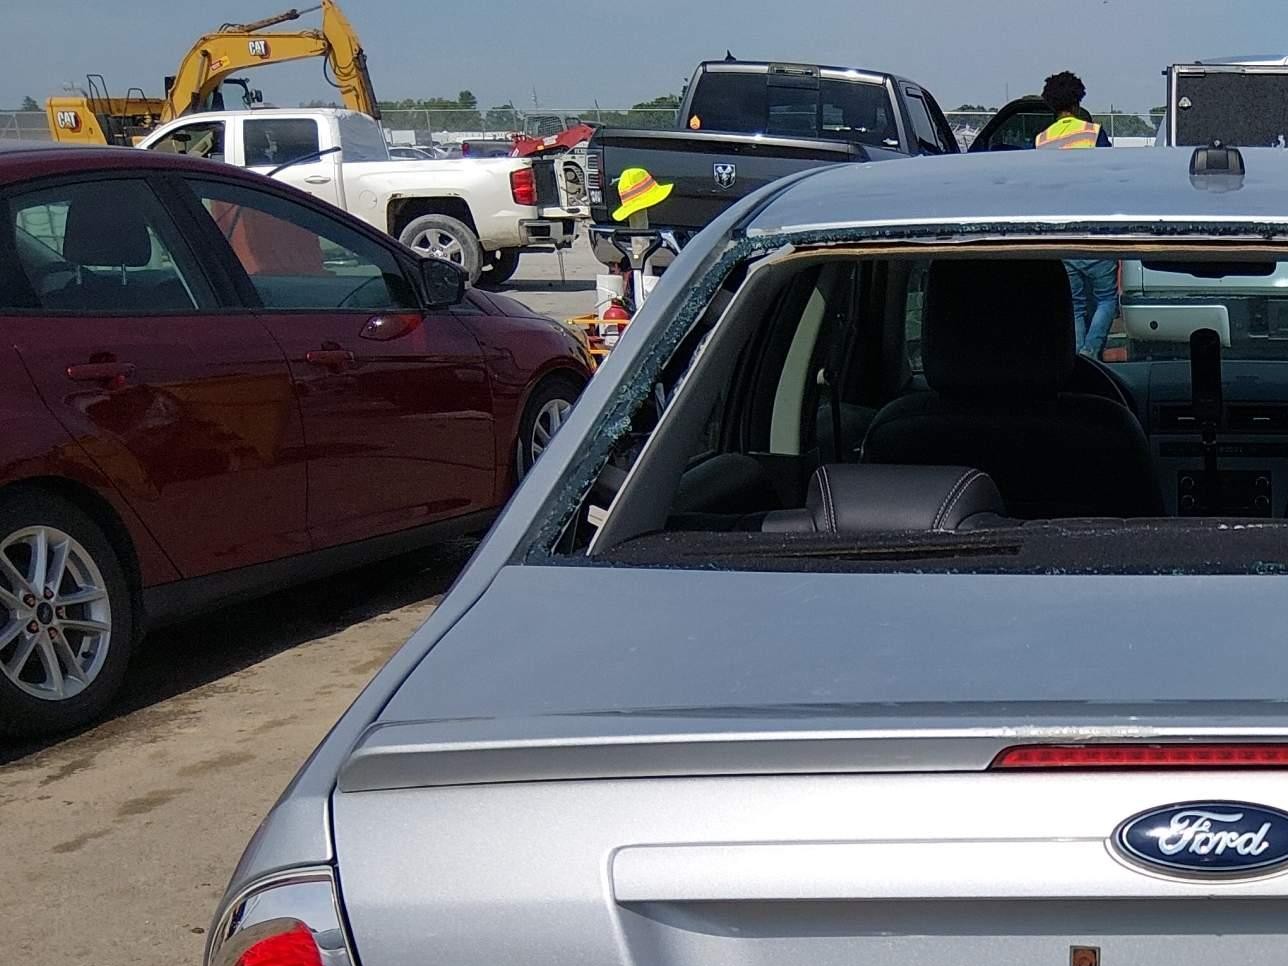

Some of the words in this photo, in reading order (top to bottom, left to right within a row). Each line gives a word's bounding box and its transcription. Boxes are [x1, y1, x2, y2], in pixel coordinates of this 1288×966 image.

[248, 40, 266, 56] CAT
[57, 111, 76, 129] CAT
[1146, 810, 1272, 856] Ford
